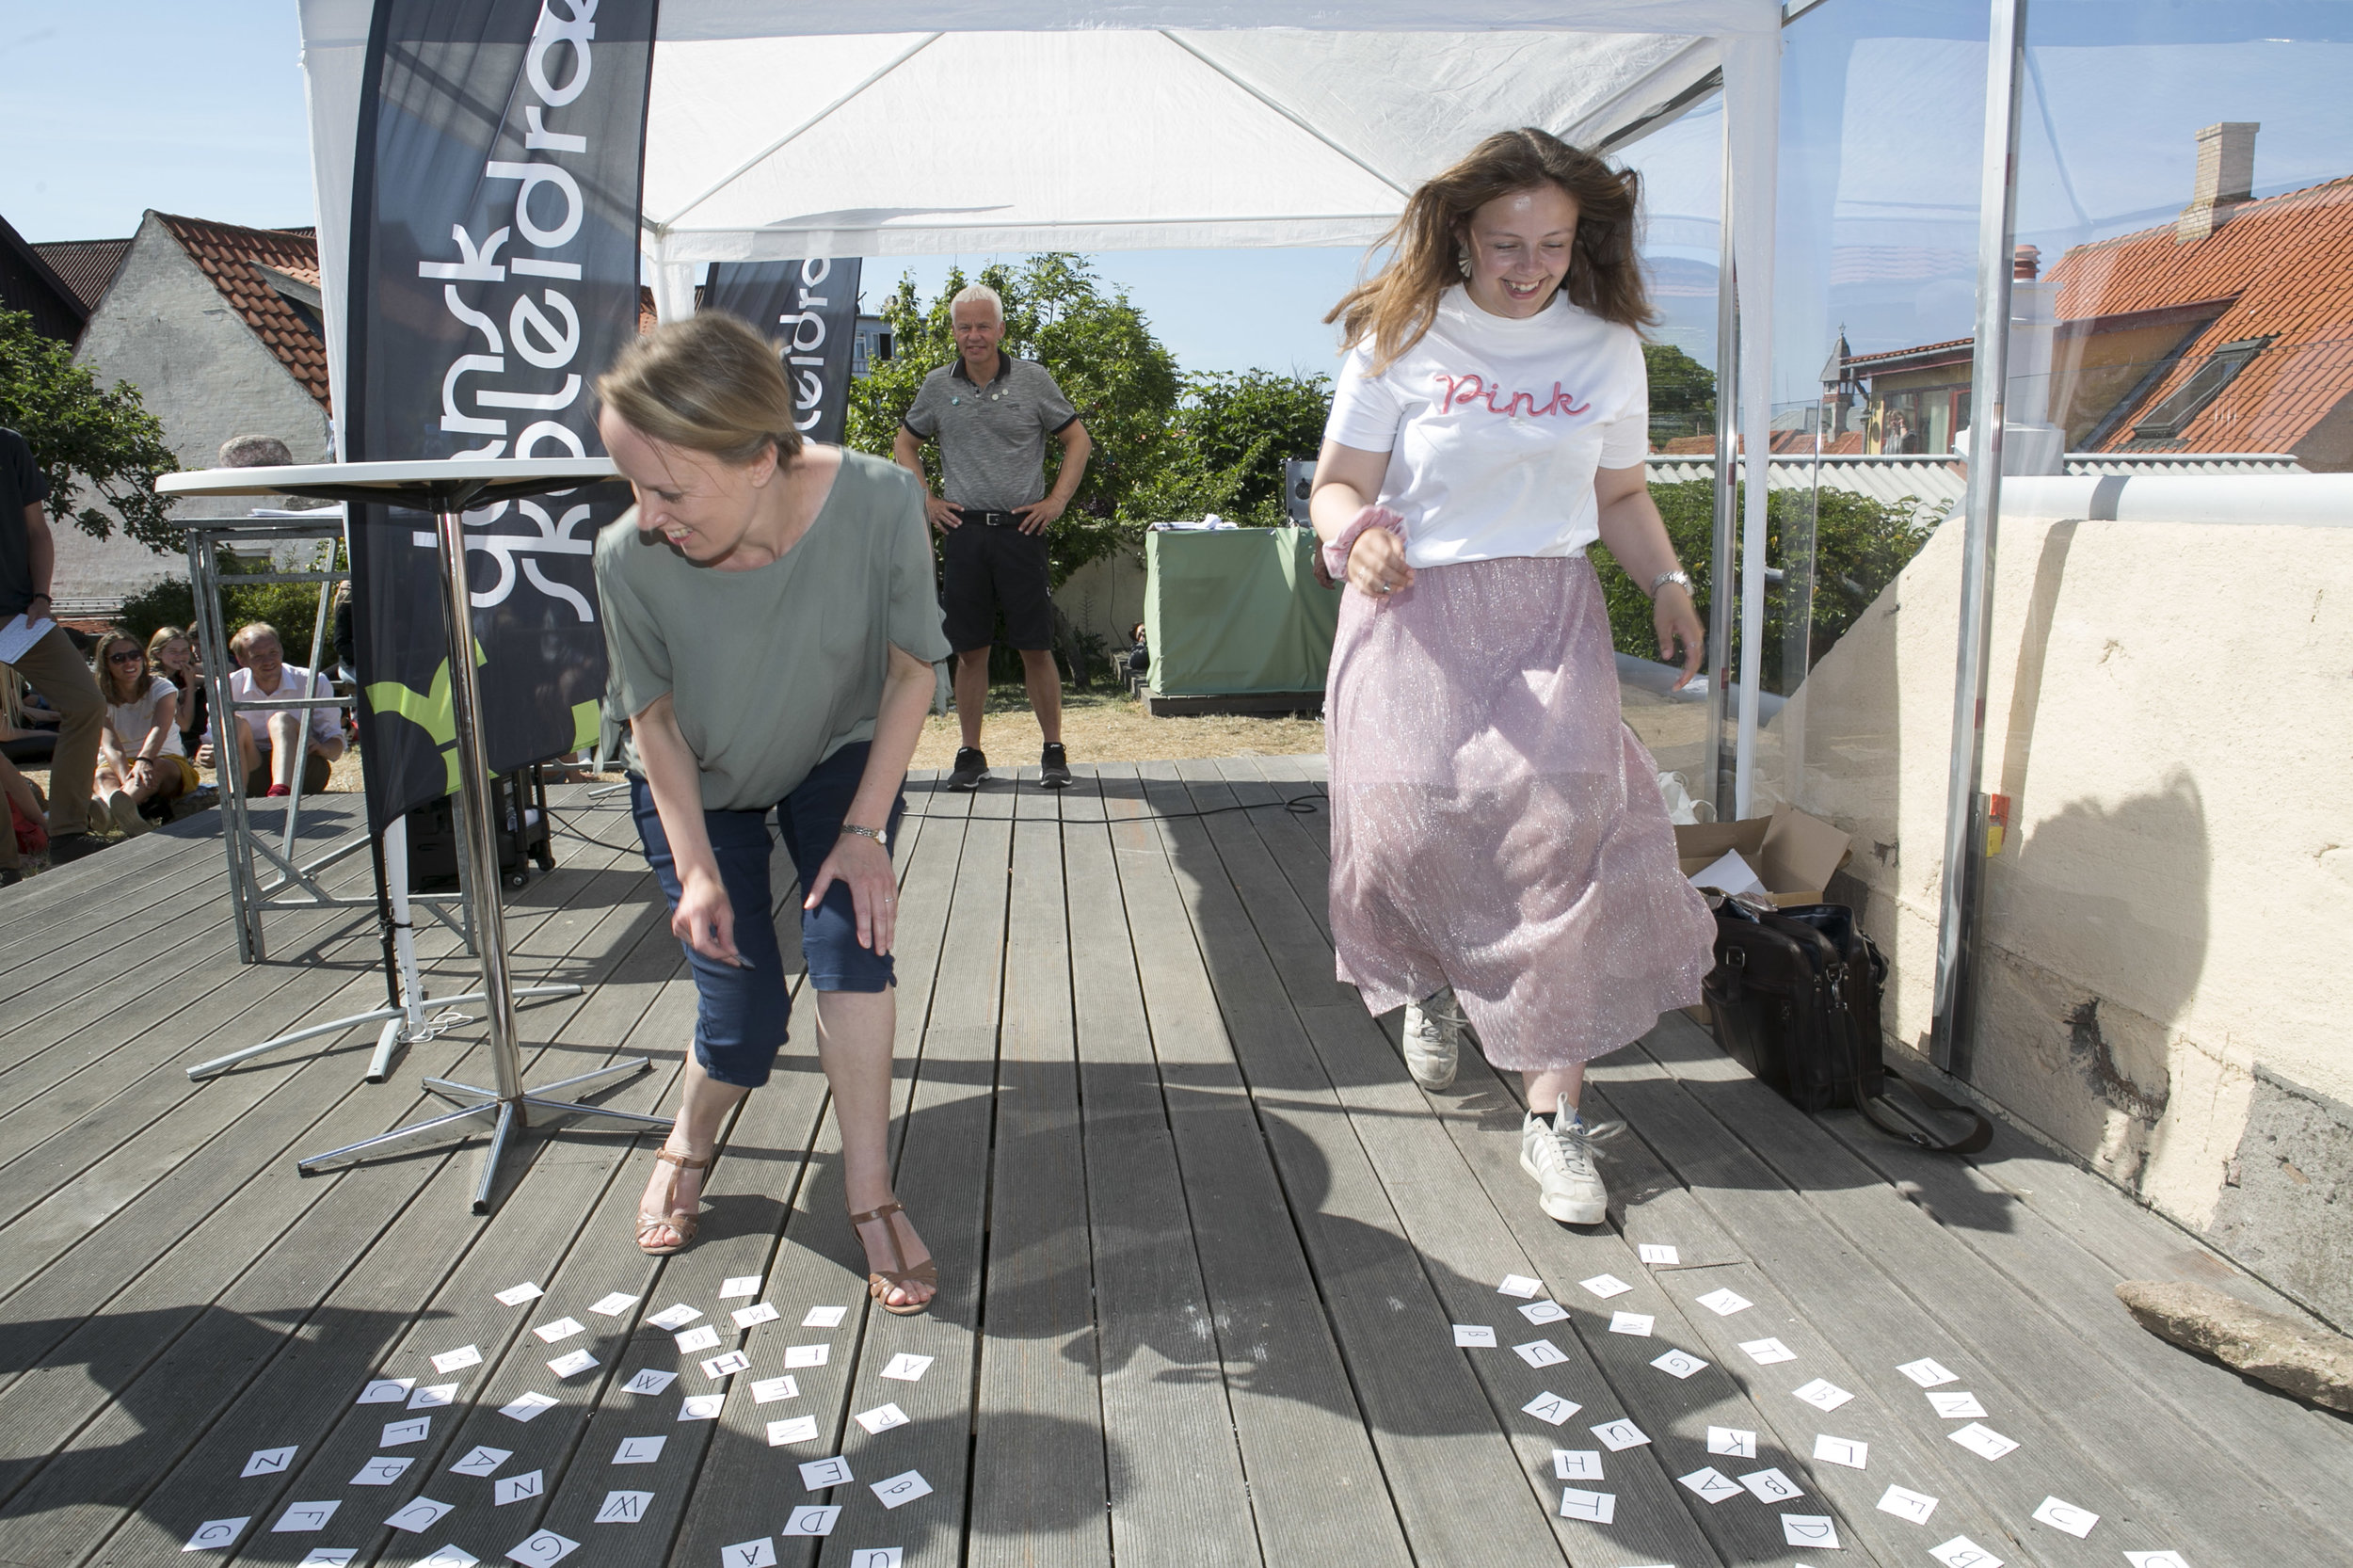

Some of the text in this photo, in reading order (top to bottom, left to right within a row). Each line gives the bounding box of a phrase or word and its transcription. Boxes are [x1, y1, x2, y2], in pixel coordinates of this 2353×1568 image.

[1433, 374, 1591, 417] Pink
[655, 1307, 690, 1323] B
[1529, 1304, 1561, 1319] O
[1461, 1330, 1489, 1338] B
[440, 1350, 476, 1366] B
[1751, 1342, 1784, 1357] T
[1669, 1357, 1691, 1372] G
[369, 1384, 406, 1398] C
[419, 1389, 448, 1403] O
[761, 1380, 790, 1399] E
[1813, 1385, 1836, 1401] B
[515, 1397, 546, 1415] T
[685, 1401, 714, 1417] O
[1535, 1400, 1561, 1419] A
[389, 1423, 424, 1436] F
[623, 1442, 644, 1459] L
[1723, 1432, 1744, 1455] K
[1972, 1429, 2009, 1456] F
[460, 1449, 497, 1467] A
[1563, 1454, 1586, 1474] H
[369, 1464, 405, 1479] P
[813, 1461, 843, 1484] E
[882, 1480, 913, 1495] B
[1700, 1474, 1735, 1491] A
[1764, 1474, 1789, 1496] B
[1565, 1495, 1601, 1517] T
[1896, 1494, 1927, 1515] F
[293, 1511, 326, 1527] F
[402, 1506, 439, 1525] C
[799, 1510, 829, 1533] D
[2048, 1507, 2078, 1526] C
[199, 1525, 232, 1540] G
[1788, 1521, 1829, 1538] D
[530, 1535, 563, 1561] G
[739, 1544, 760, 1568] Ä
[308, 1556, 348, 1567] K
